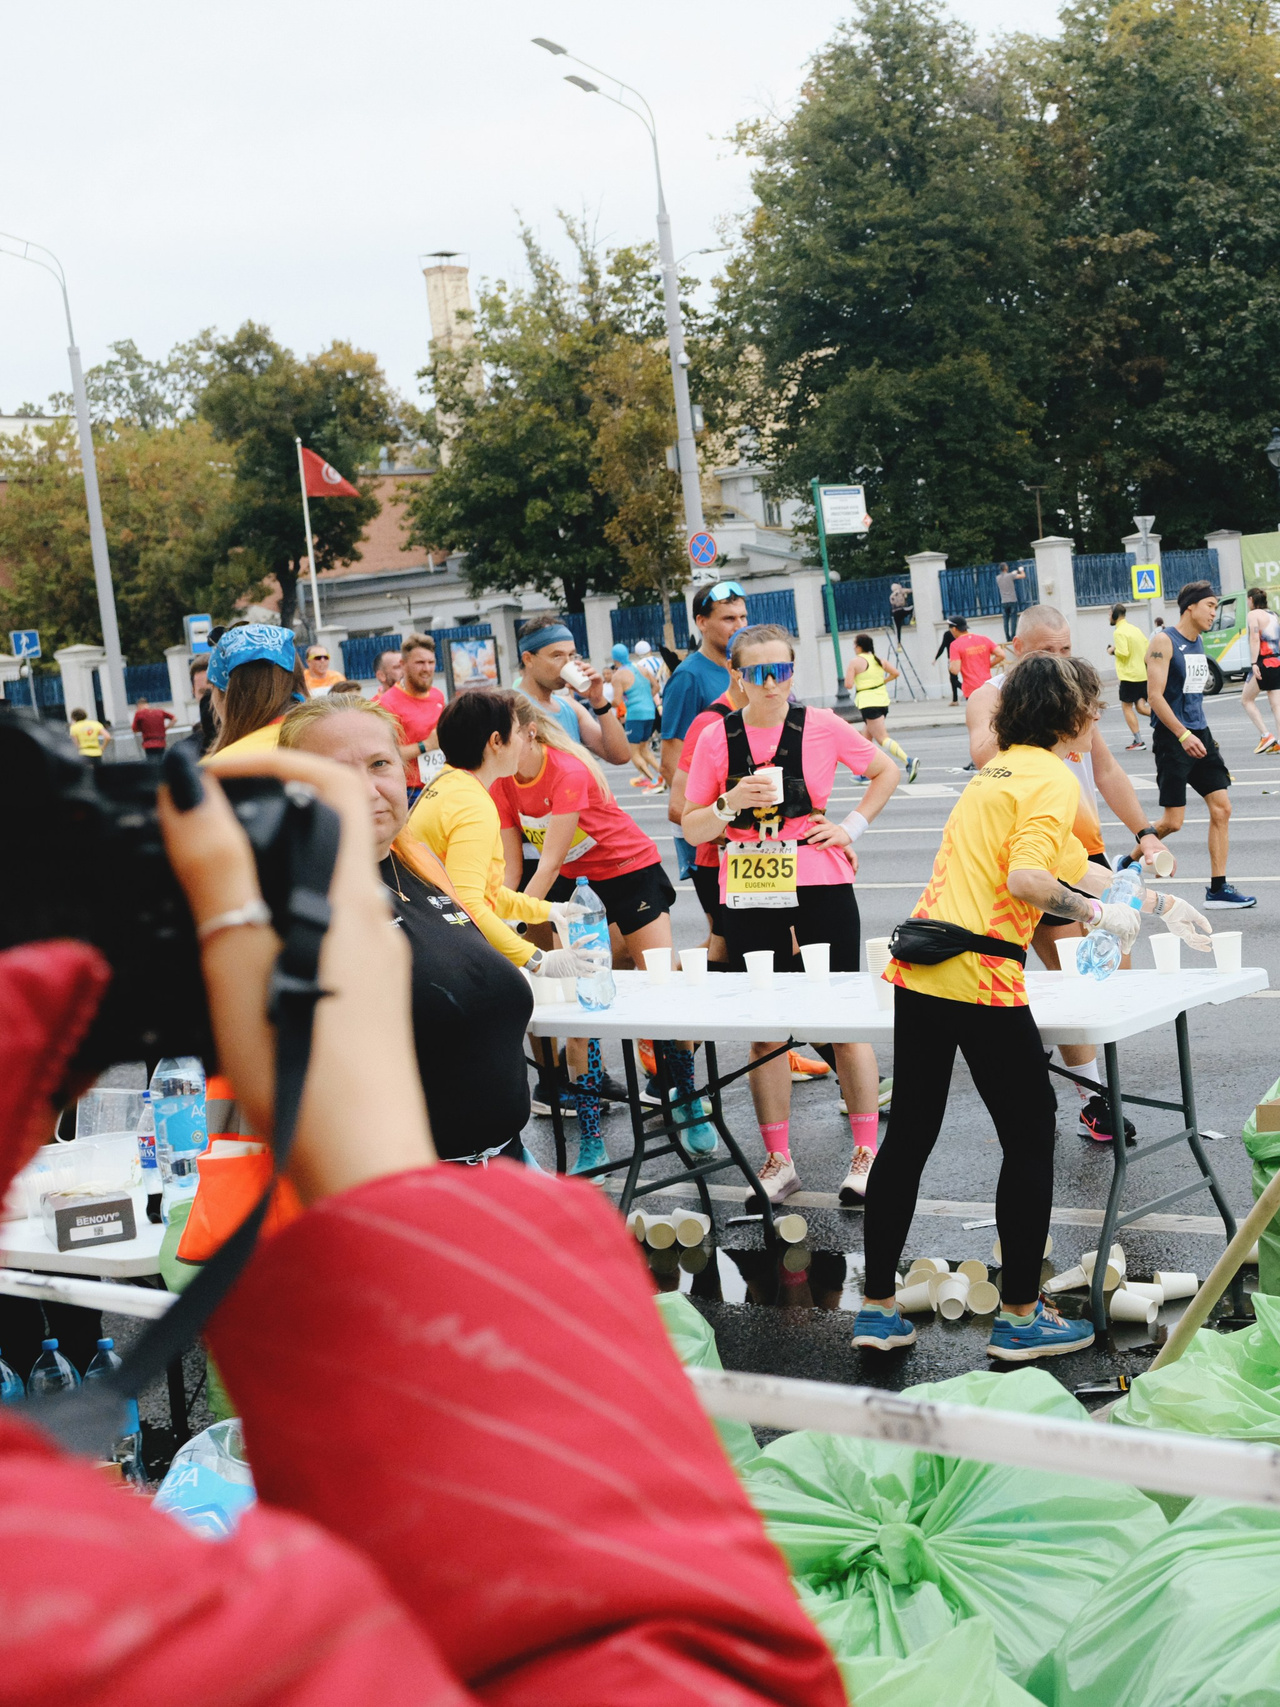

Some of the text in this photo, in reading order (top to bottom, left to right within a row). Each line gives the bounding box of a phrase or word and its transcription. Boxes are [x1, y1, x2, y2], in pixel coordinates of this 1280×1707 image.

[1187, 665, 1208, 677] 11659
[731, 858, 794, 879] 12635
[733, 895, 740, 907] F
